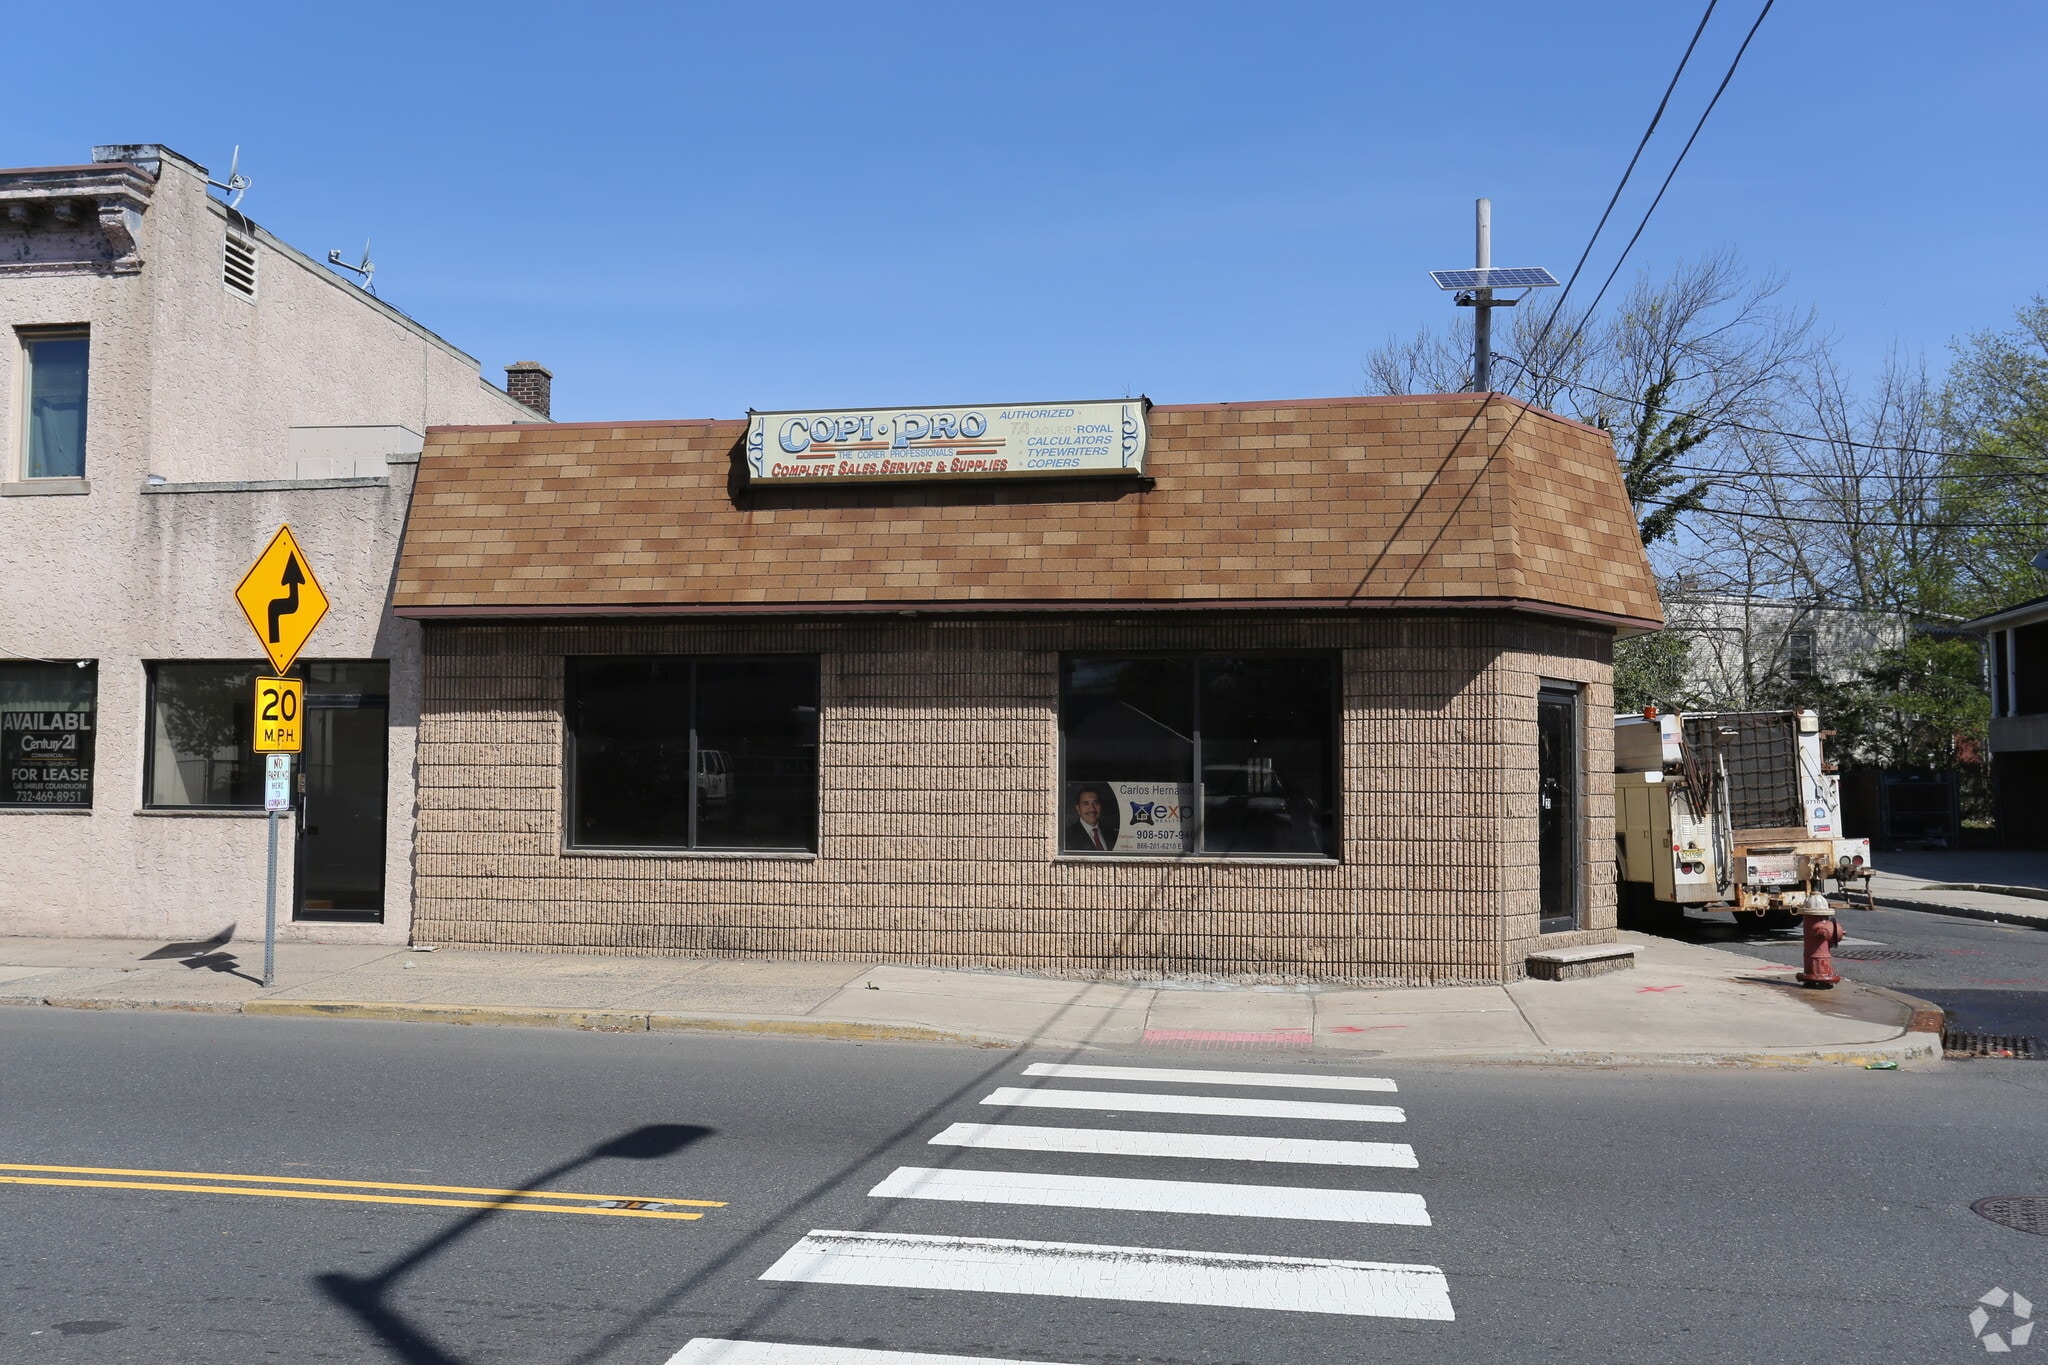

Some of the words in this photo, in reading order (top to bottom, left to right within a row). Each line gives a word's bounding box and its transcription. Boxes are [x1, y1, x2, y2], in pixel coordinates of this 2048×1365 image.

[999, 409, 1075, 420] AUTHORIZED
[1027, 435, 1112, 446] CALCULATORS
[838, 451, 853, 460] THE
[857, 450, 886, 460] COPIER
[890, 448, 954, 459] PROFESSIONALS
[1027, 446, 1109, 457] TYPEWRITERS
[771, 462, 836, 477] COMPLETE
[935, 460, 947, 473] &
[950, 458, 1008, 473] SUPPLIES
[1027, 458, 1080, 468] COPIERS
[261, 688, 296, 722] 20
[3, 713, 91, 731] AVAILABL
[273, 758, 283, 769] NO
[12, 768, 38, 781] FOR
[43, 768, 89, 781] LEASE
[268, 770, 289, 780] PARKING
[271, 781, 284, 790] HERE
[1119, 784, 1149, 796] Carlos
[16, 790, 81, 802] 732-469-8951
[268, 798, 287, 807] CORNER
